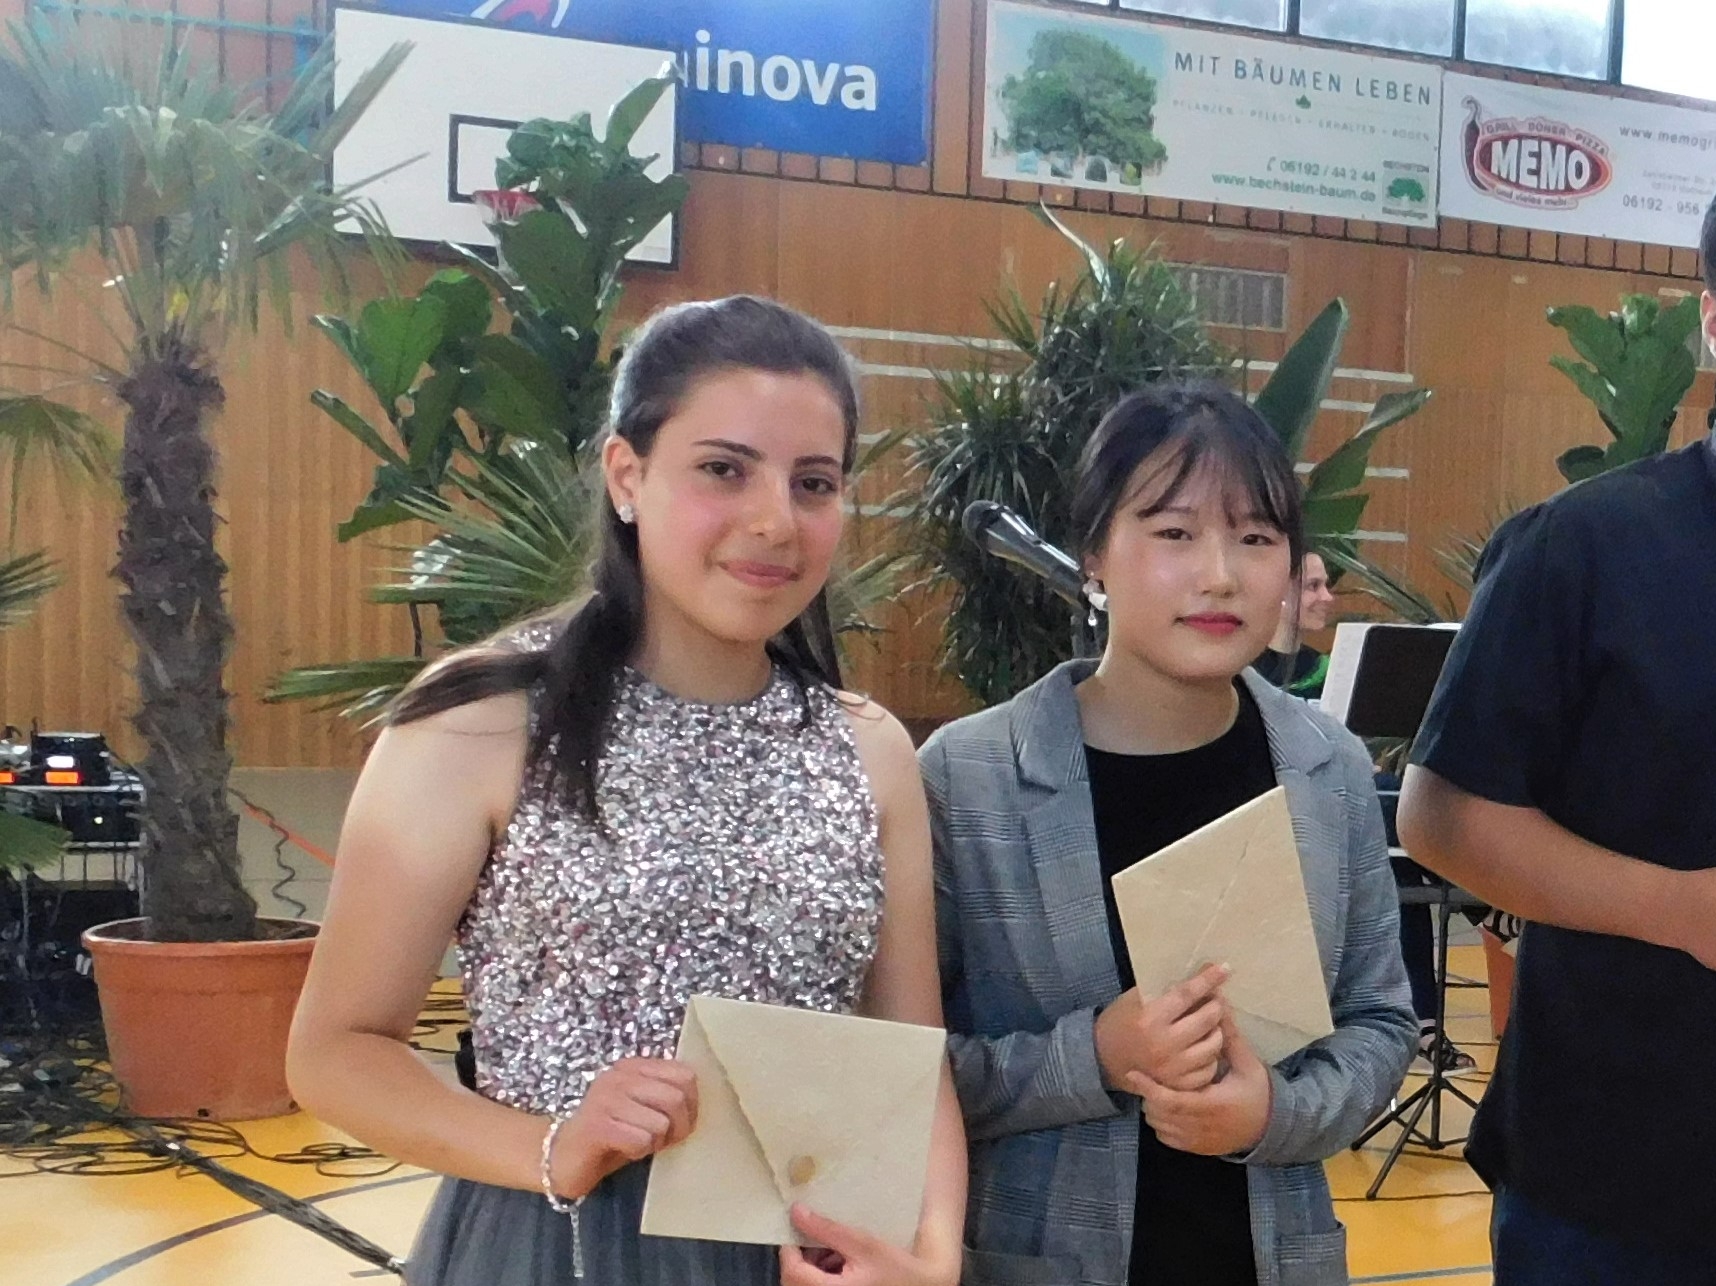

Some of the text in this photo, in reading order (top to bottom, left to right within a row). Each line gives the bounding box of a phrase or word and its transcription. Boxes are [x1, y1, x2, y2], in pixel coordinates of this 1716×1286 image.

[684, 29, 877, 111] inova
[1174, 52, 1431, 105] MIT BÄUMEN LEBEN
[1279, 160, 1320, 177] 06192
[1490, 138, 1590, 190] MEMO
[1622, 194, 1663, 212] 06192
